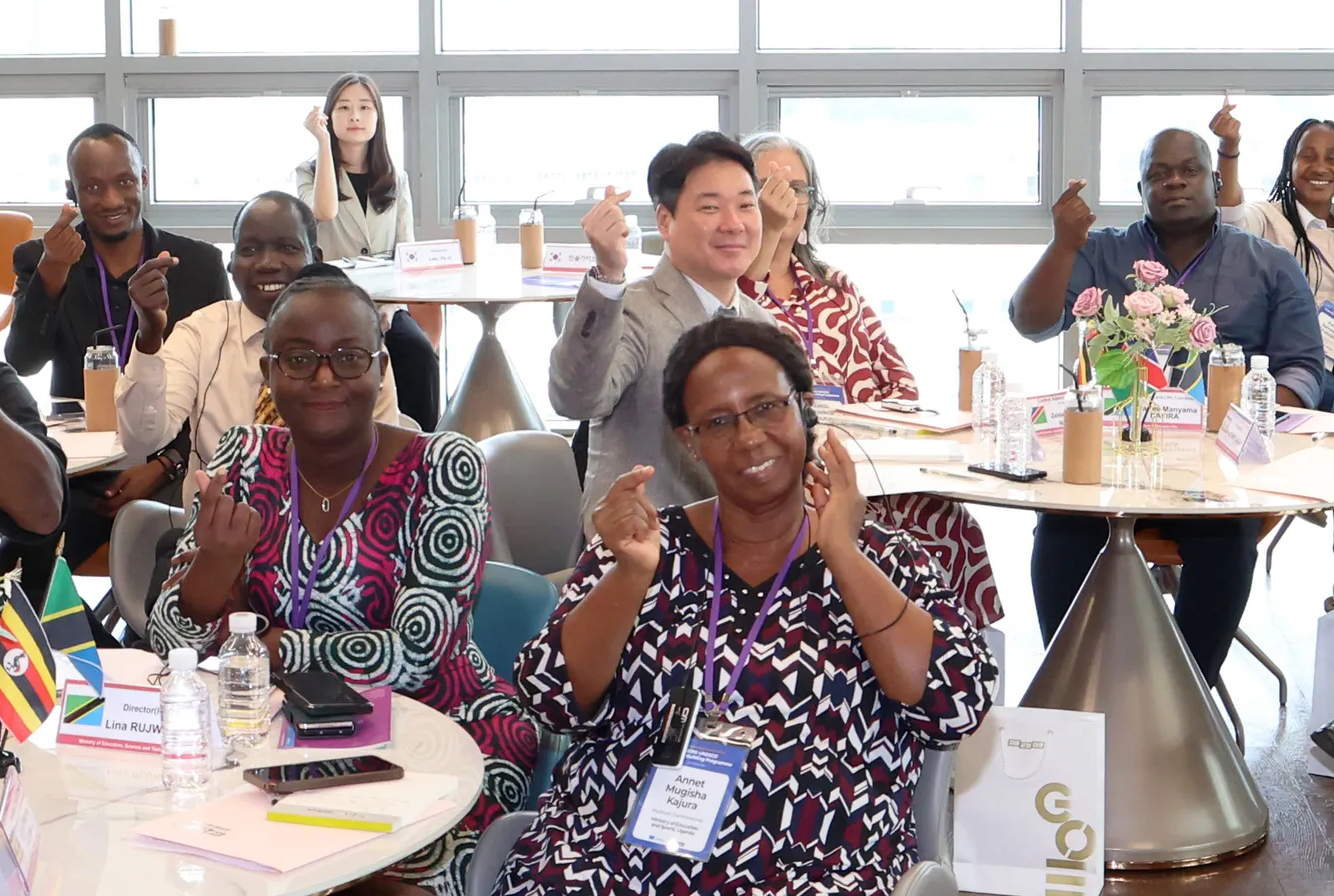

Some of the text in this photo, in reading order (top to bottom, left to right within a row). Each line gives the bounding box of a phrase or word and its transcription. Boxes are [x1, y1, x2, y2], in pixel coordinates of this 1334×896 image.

[105, 719, 162, 734] Lina RUJW
[675, 774, 706, 788] Annet
[665, 784, 708, 802] Mugisha
[666, 796, 698, 811] Kajura
[651, 817, 670, 826] Ministry
[675, 821, 699, 831] Education
[677, 827, 695, 836] Uganda
